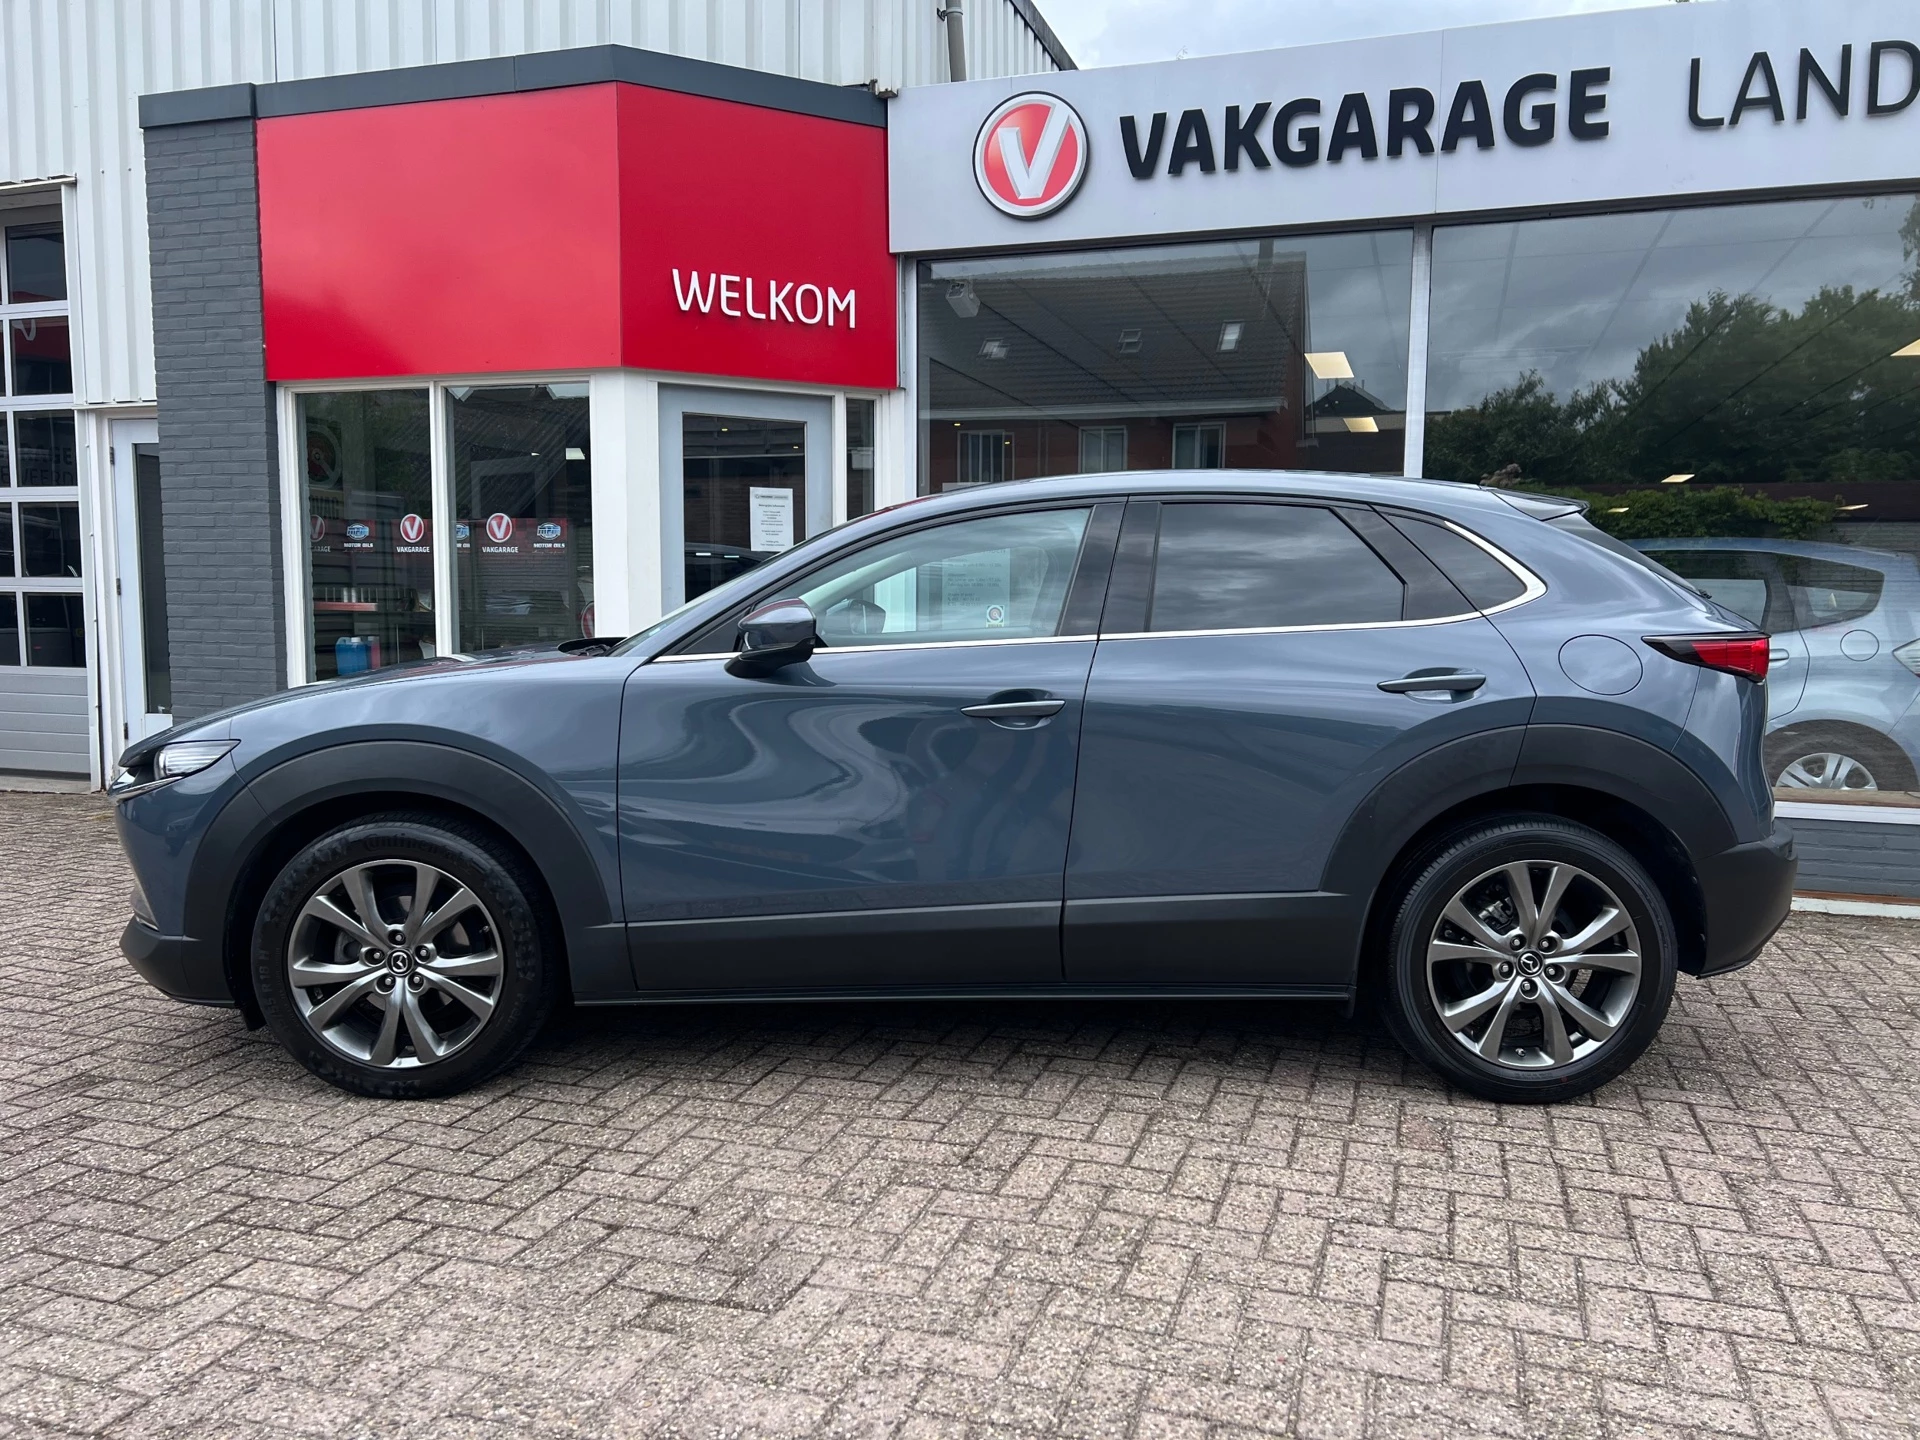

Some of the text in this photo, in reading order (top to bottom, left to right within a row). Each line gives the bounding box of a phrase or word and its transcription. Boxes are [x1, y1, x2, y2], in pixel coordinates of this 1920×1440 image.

[1119, 39, 1920, 179] VAKGARAGE LAND
[671, 268, 857, 329] WELKOM
